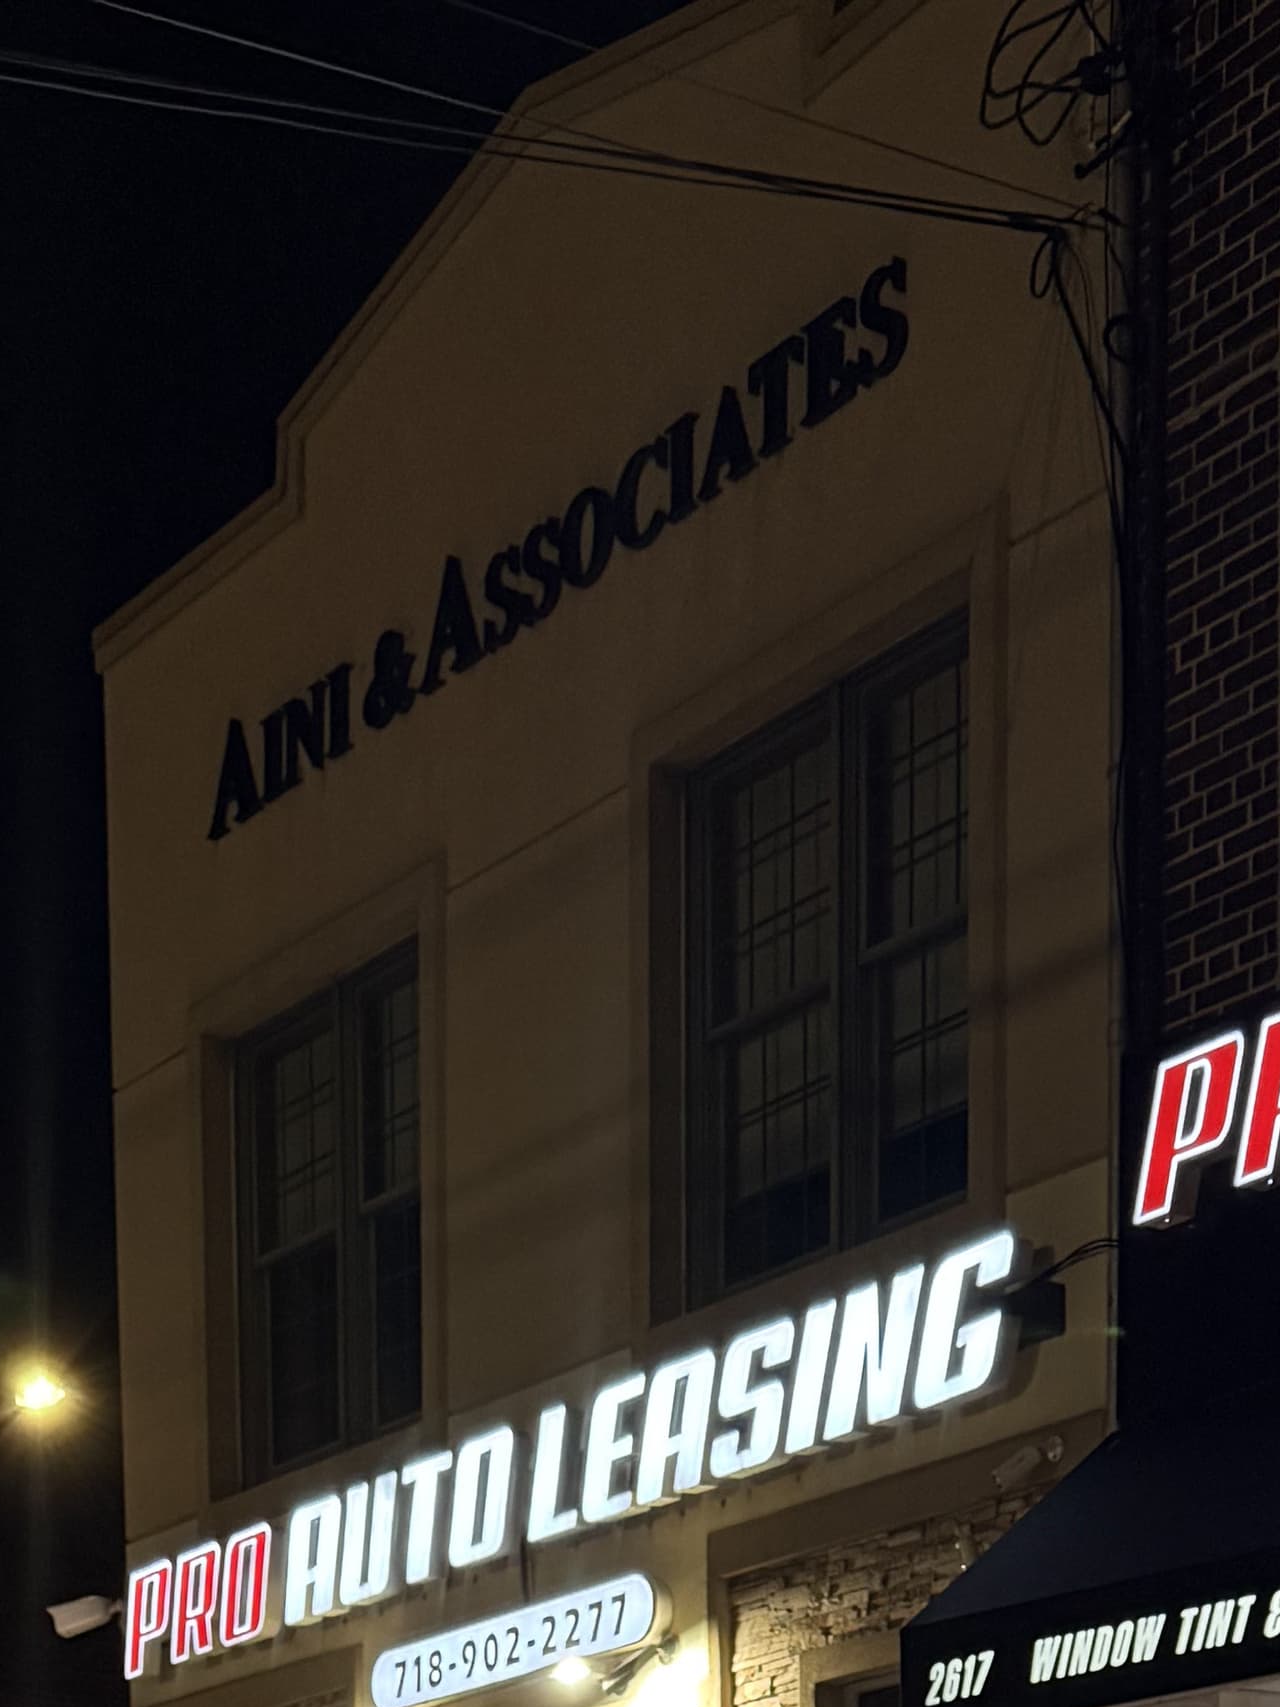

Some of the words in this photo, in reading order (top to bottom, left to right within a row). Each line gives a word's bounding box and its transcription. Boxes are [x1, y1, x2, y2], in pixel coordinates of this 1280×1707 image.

[207, 661, 353, 842] AINI
[363, 628, 418, 730] &
[420, 256, 910, 696] ASSOCIATES
[123, 1520, 272, 1680] PRO
[283, 1423, 516, 1628] AUTO
[526, 1229, 1016, 1545] LEASING
[394, 1593, 626, 1698] 718-902-2277
[923, 1648, 996, 1707] 2617
[1028, 1612, 1167, 1686] WINDOW
[1176, 1593, 1257, 1655] TINT
